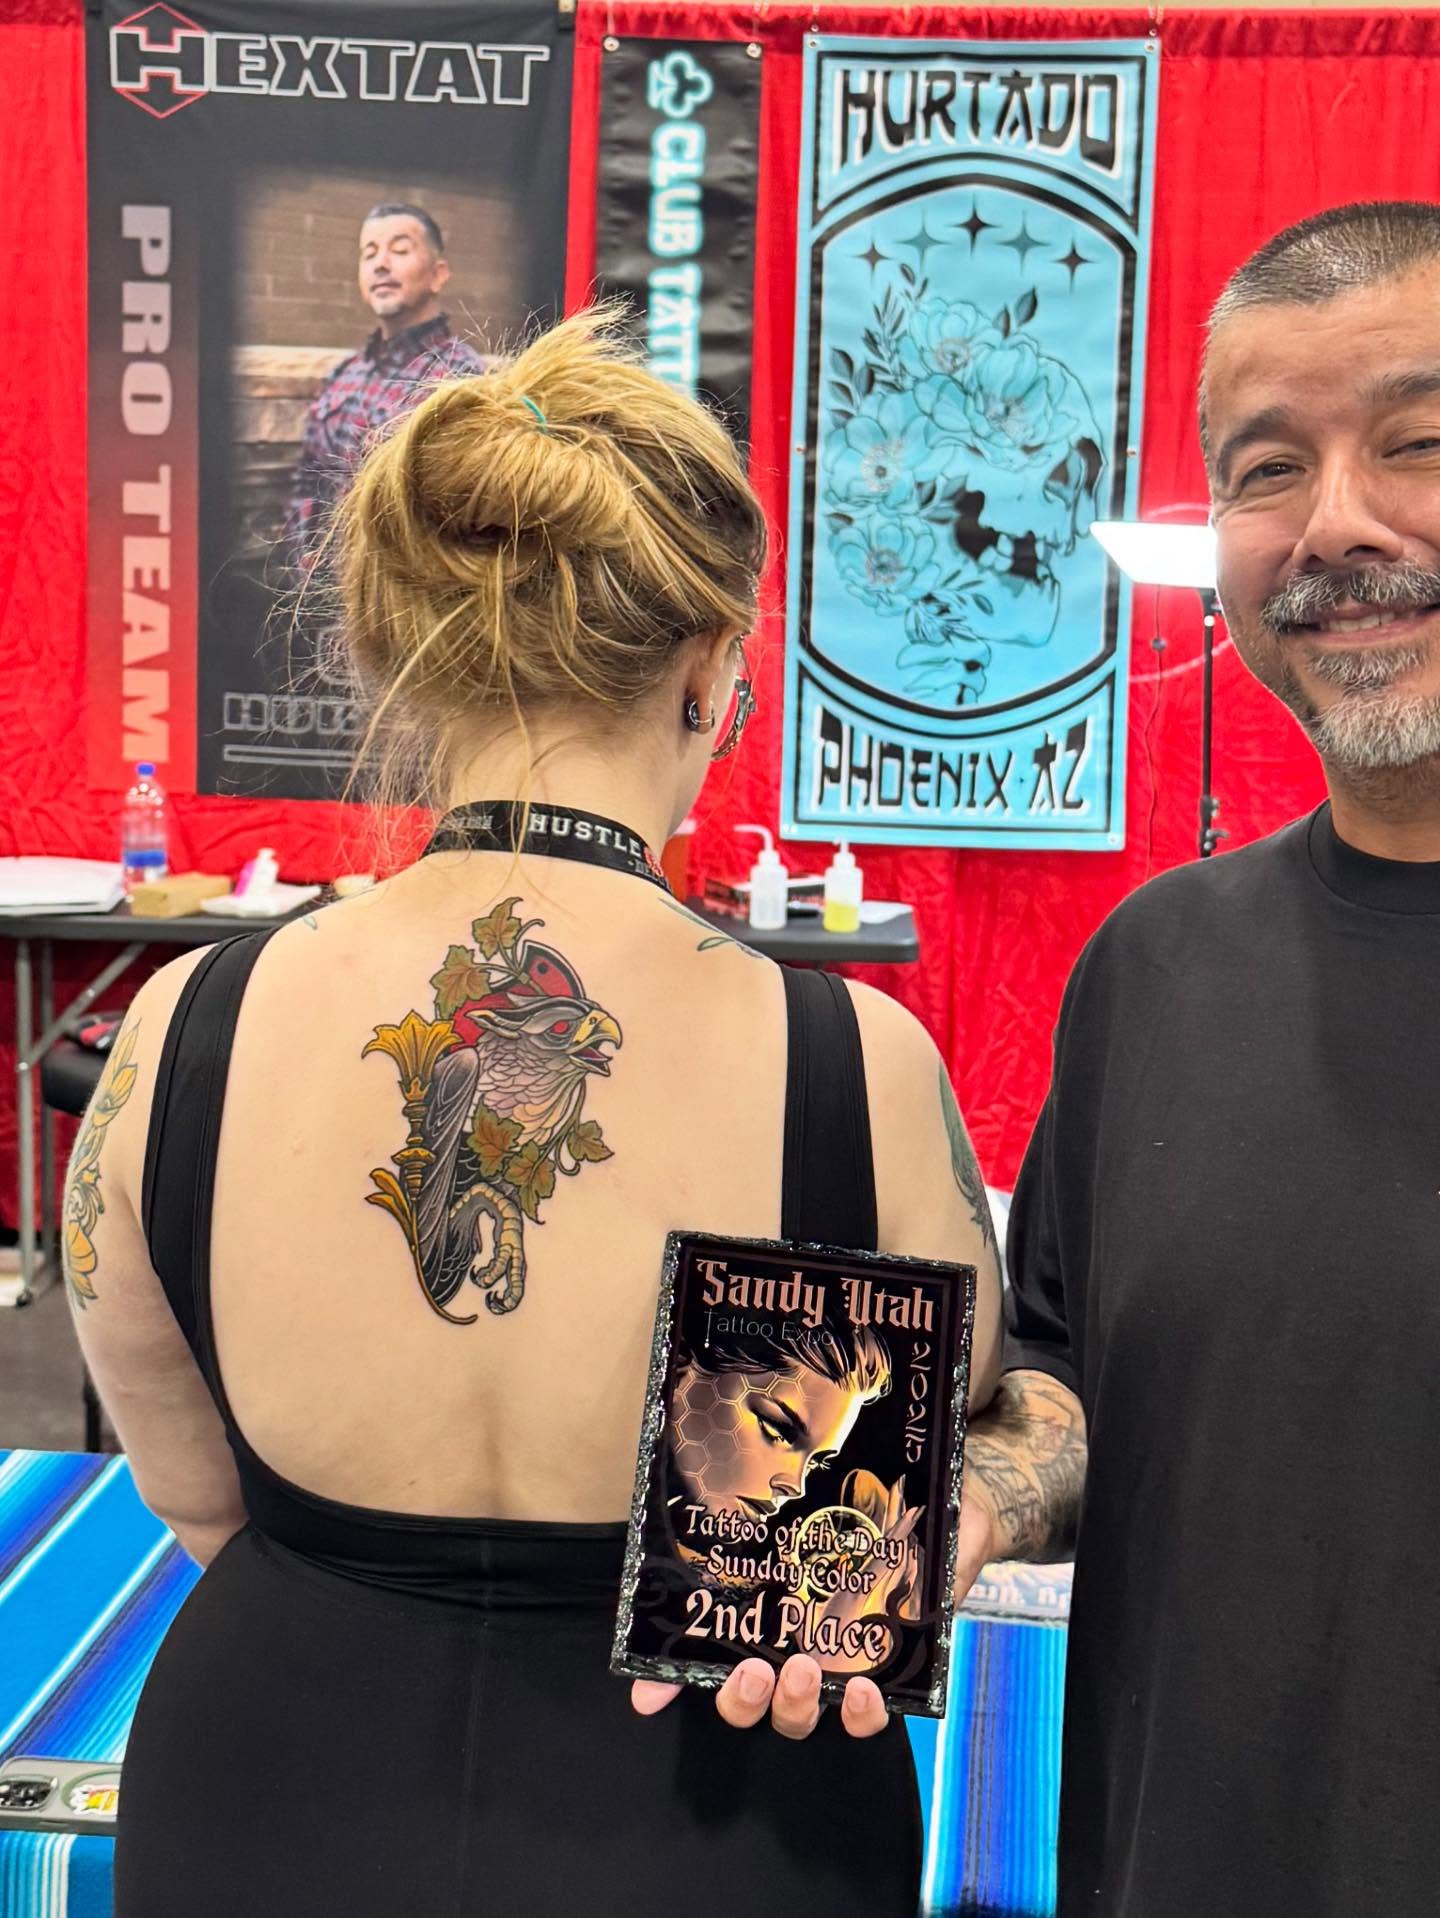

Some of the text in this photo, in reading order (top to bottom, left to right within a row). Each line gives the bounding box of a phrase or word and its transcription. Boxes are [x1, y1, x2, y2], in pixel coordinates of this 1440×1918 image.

[110, 26, 549, 105] HEXTAT
[833, 68, 1121, 178] HURTADO
[648, 122, 704, 400] CLUB TATT
[122, 205, 171, 762] PRO TEAM
[528, 812, 642, 858] HUSTLE
[696, 1258, 934, 1332] Sandy Utah
[704, 1308, 833, 1348] Tattoo Expo
[905, 1342, 931, 1463] 2025
[684, 1504, 905, 1569] Tattoo of the Day
[706, 1544, 875, 1594] Sunday Color
[684, 1588, 887, 1661] 2nd Place
